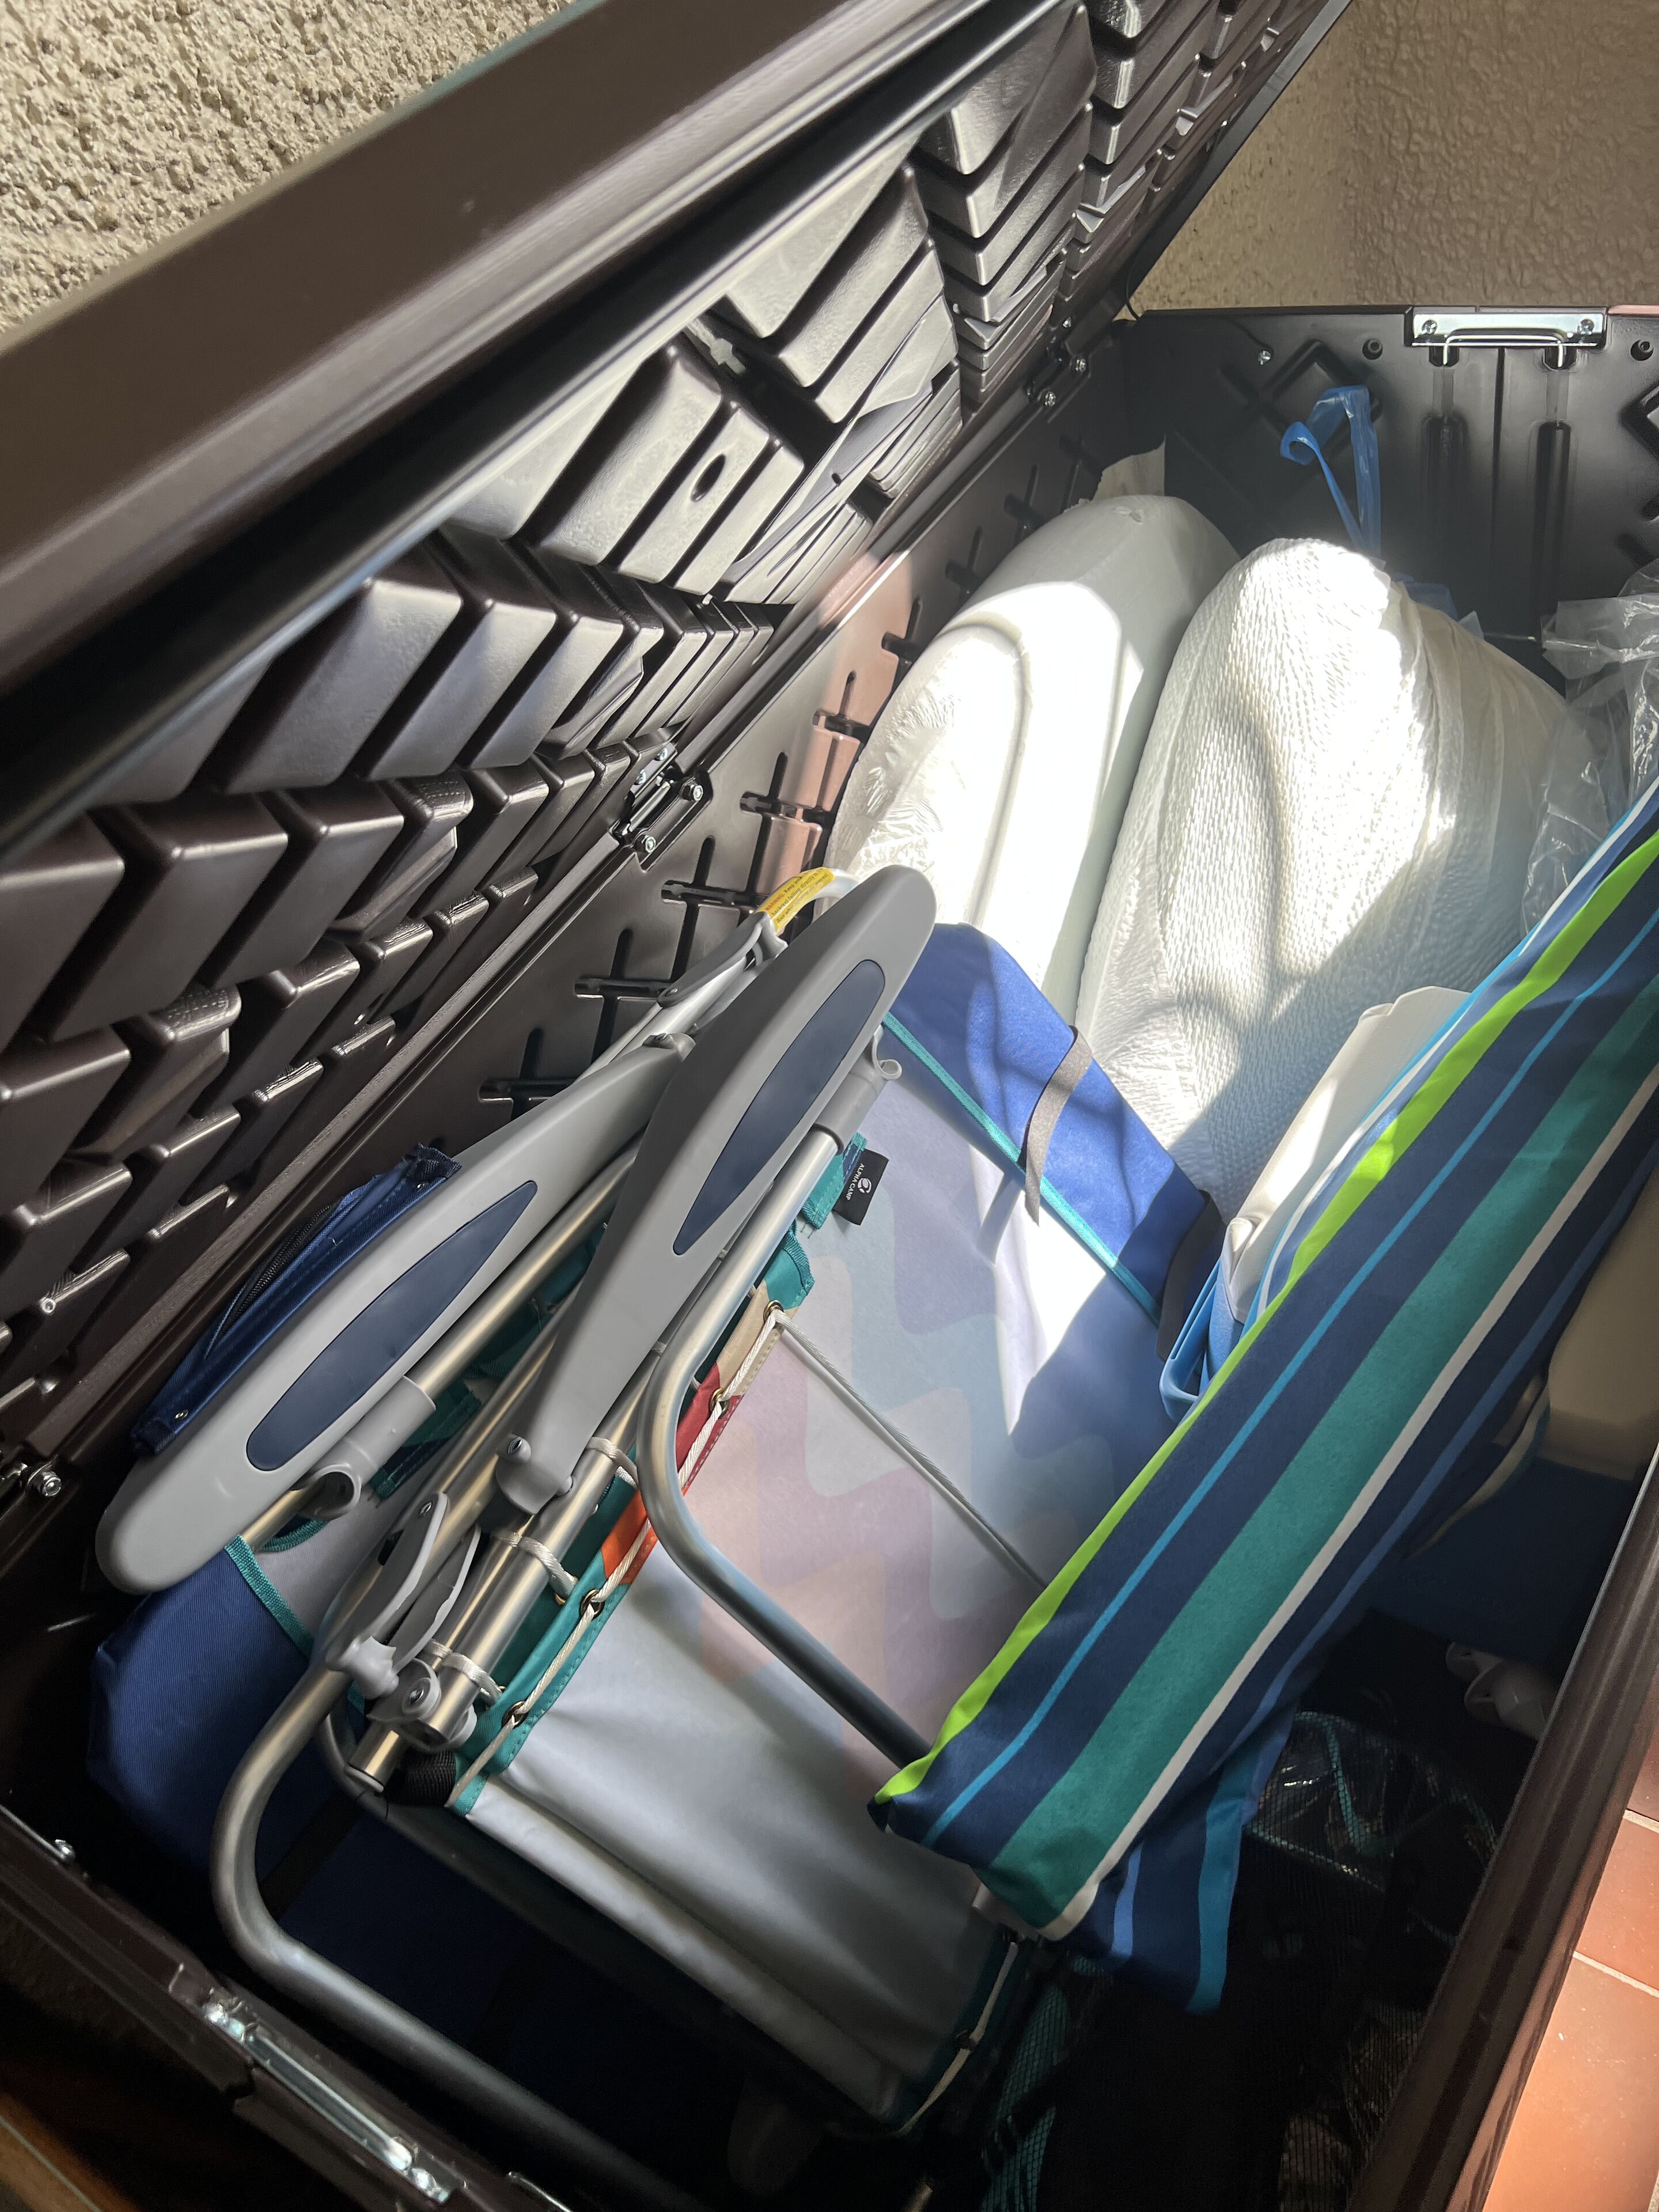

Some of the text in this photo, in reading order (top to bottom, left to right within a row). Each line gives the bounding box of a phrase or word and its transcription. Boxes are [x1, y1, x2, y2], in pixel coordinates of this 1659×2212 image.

[772, 899, 788, 916] backrest
[787, 888, 801, 901] falling
[784, 884, 794, 893] Keep
[846, 1163, 865, 1200] ALPHA CAMP
